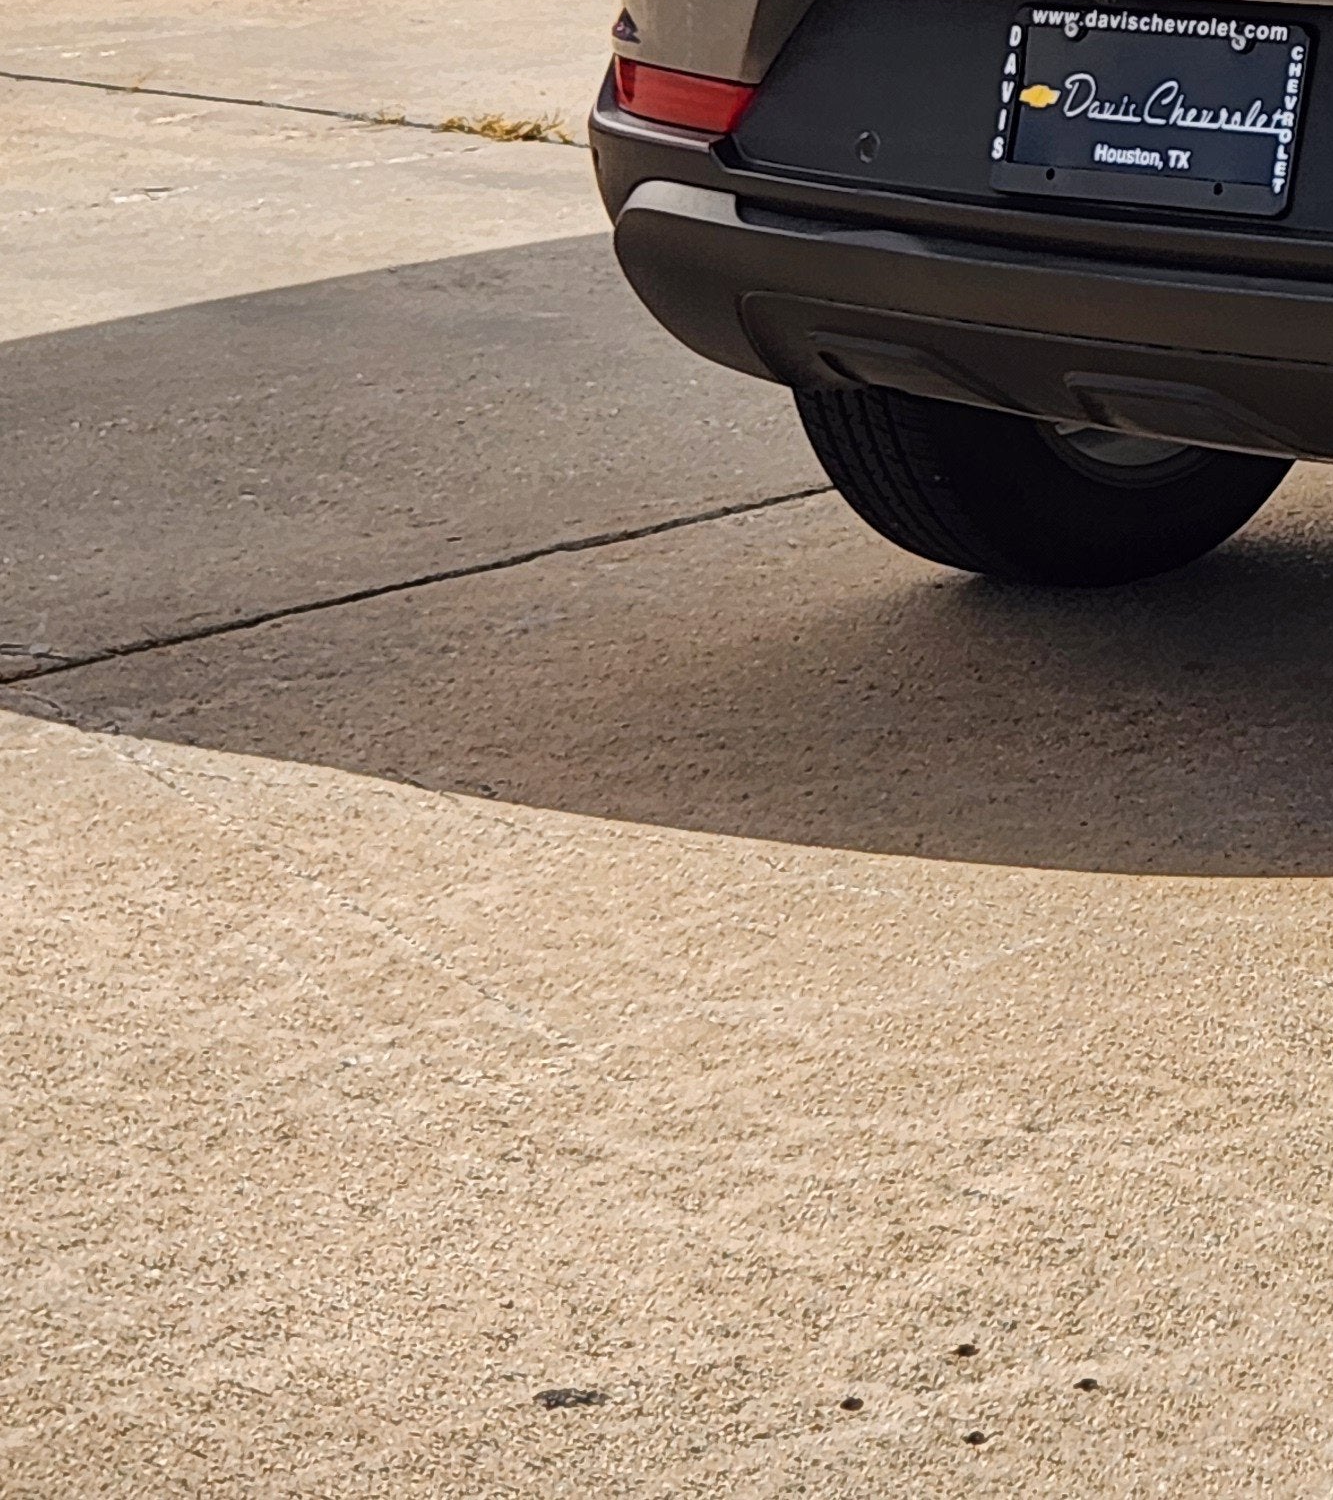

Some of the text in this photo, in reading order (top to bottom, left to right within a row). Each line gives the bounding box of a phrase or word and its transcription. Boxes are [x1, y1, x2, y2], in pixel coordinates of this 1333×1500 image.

[1032, 9, 1289, 41] www.davischevroletcom
[992, 25, 1022, 159] DAVIS
[1063, 72, 1283, 134] Davis Chevrolet
[1272, 46, 1305, 194] CHEVROLET
[1093, 143, 1191, 170] Houston, TX
